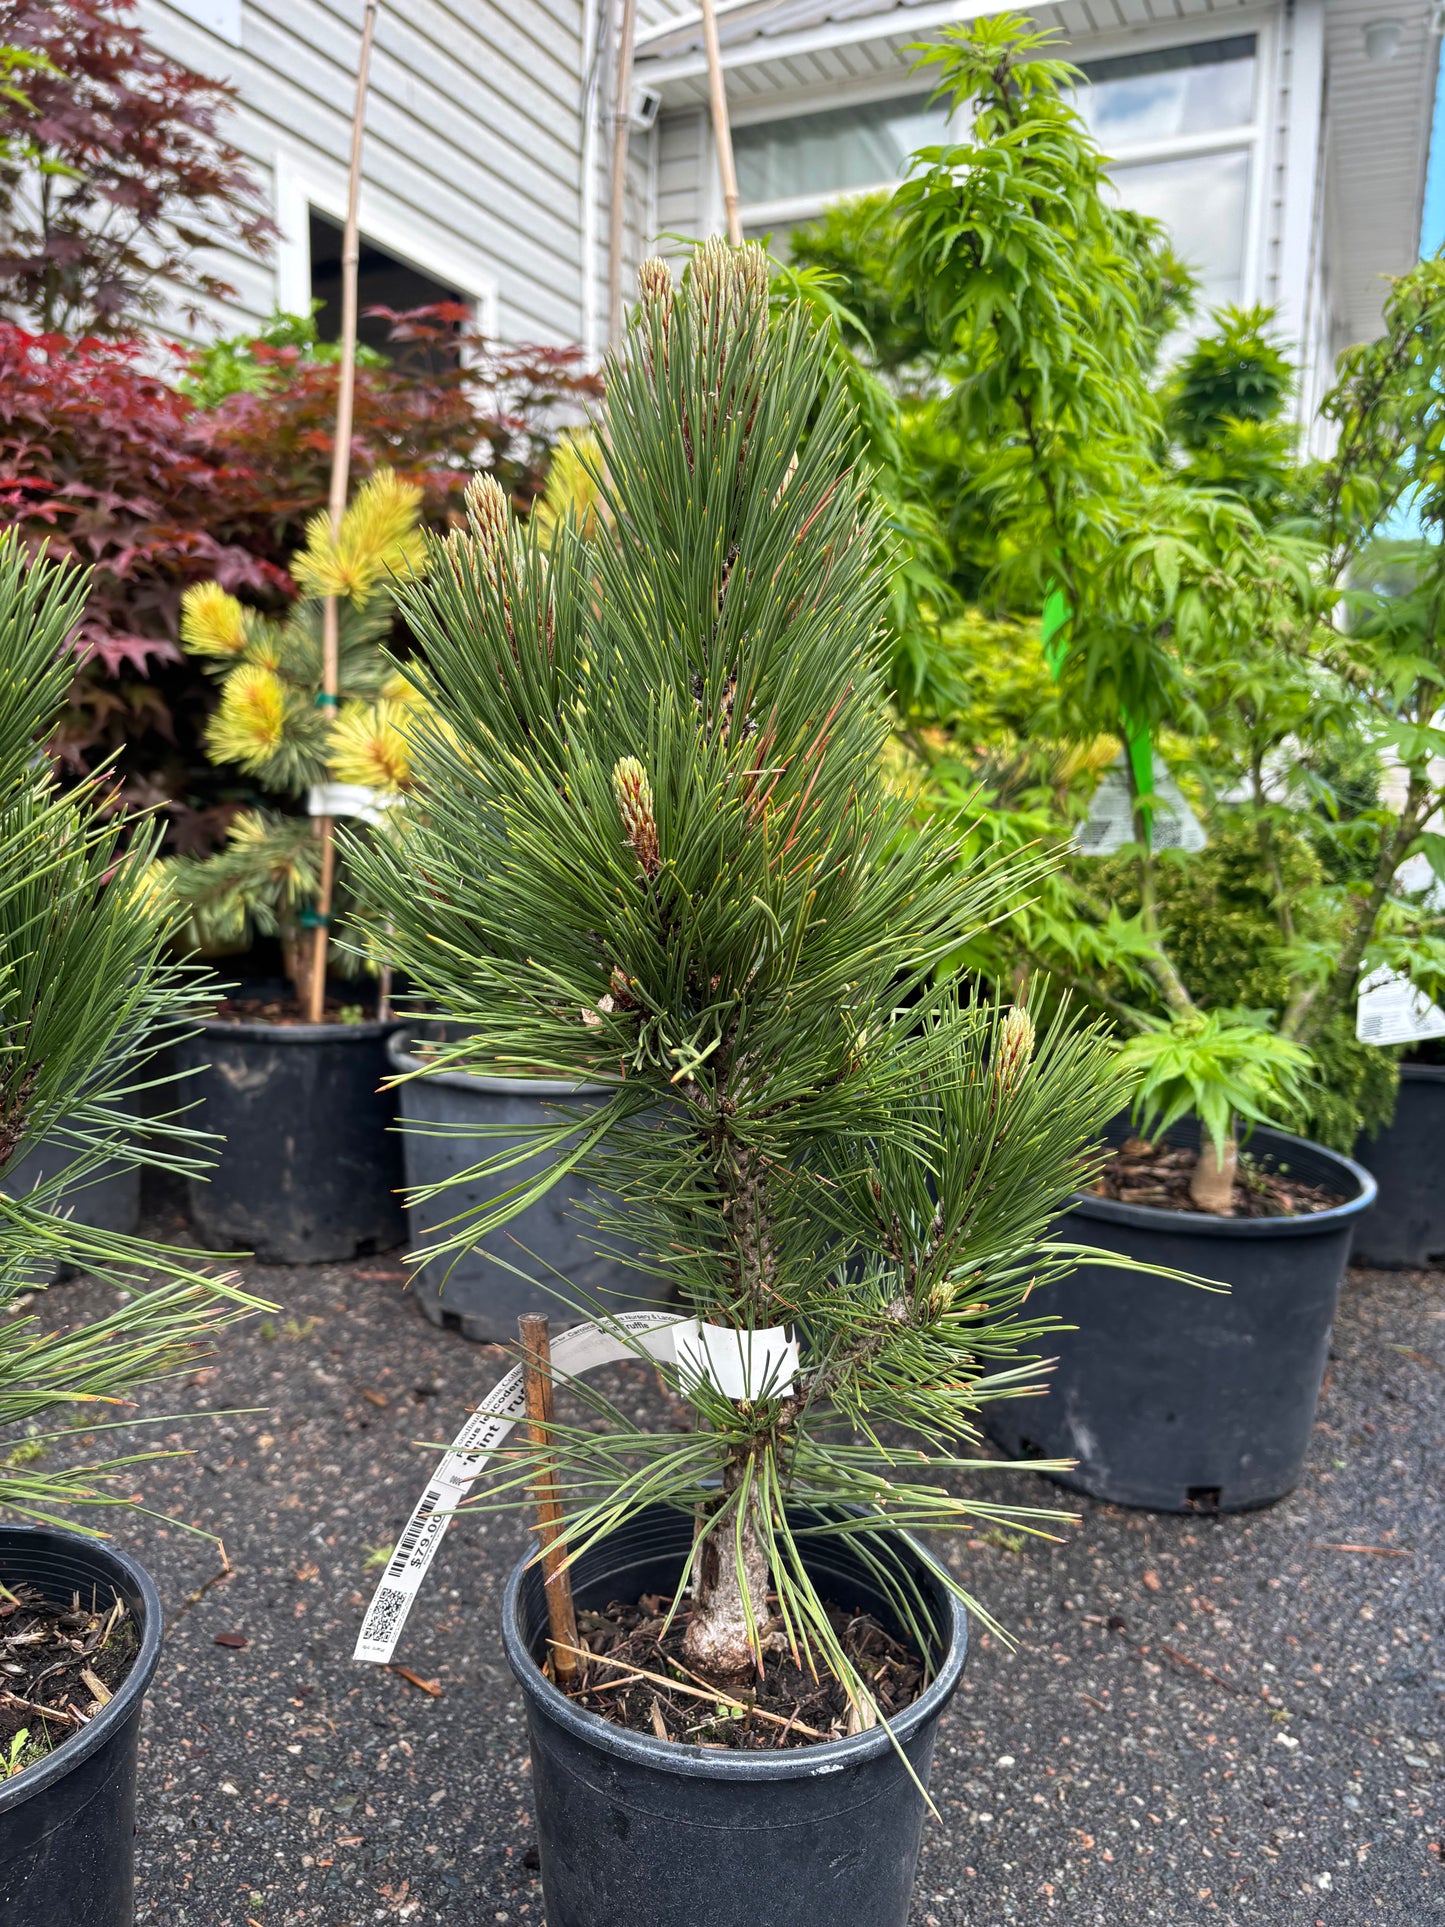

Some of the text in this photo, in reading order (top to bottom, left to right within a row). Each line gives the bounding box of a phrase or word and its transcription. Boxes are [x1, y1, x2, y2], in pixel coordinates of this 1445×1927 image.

[567, 1323, 596, 1337] Carolina
[624, 1313, 651, 1322] Nursery
[454, 1411, 483, 1447] oodlan
[502, 1366, 524, 1388] Colle
[456, 1427, 482, 1458] Pnus
[410, 1514, 444, 1569] $79.00
